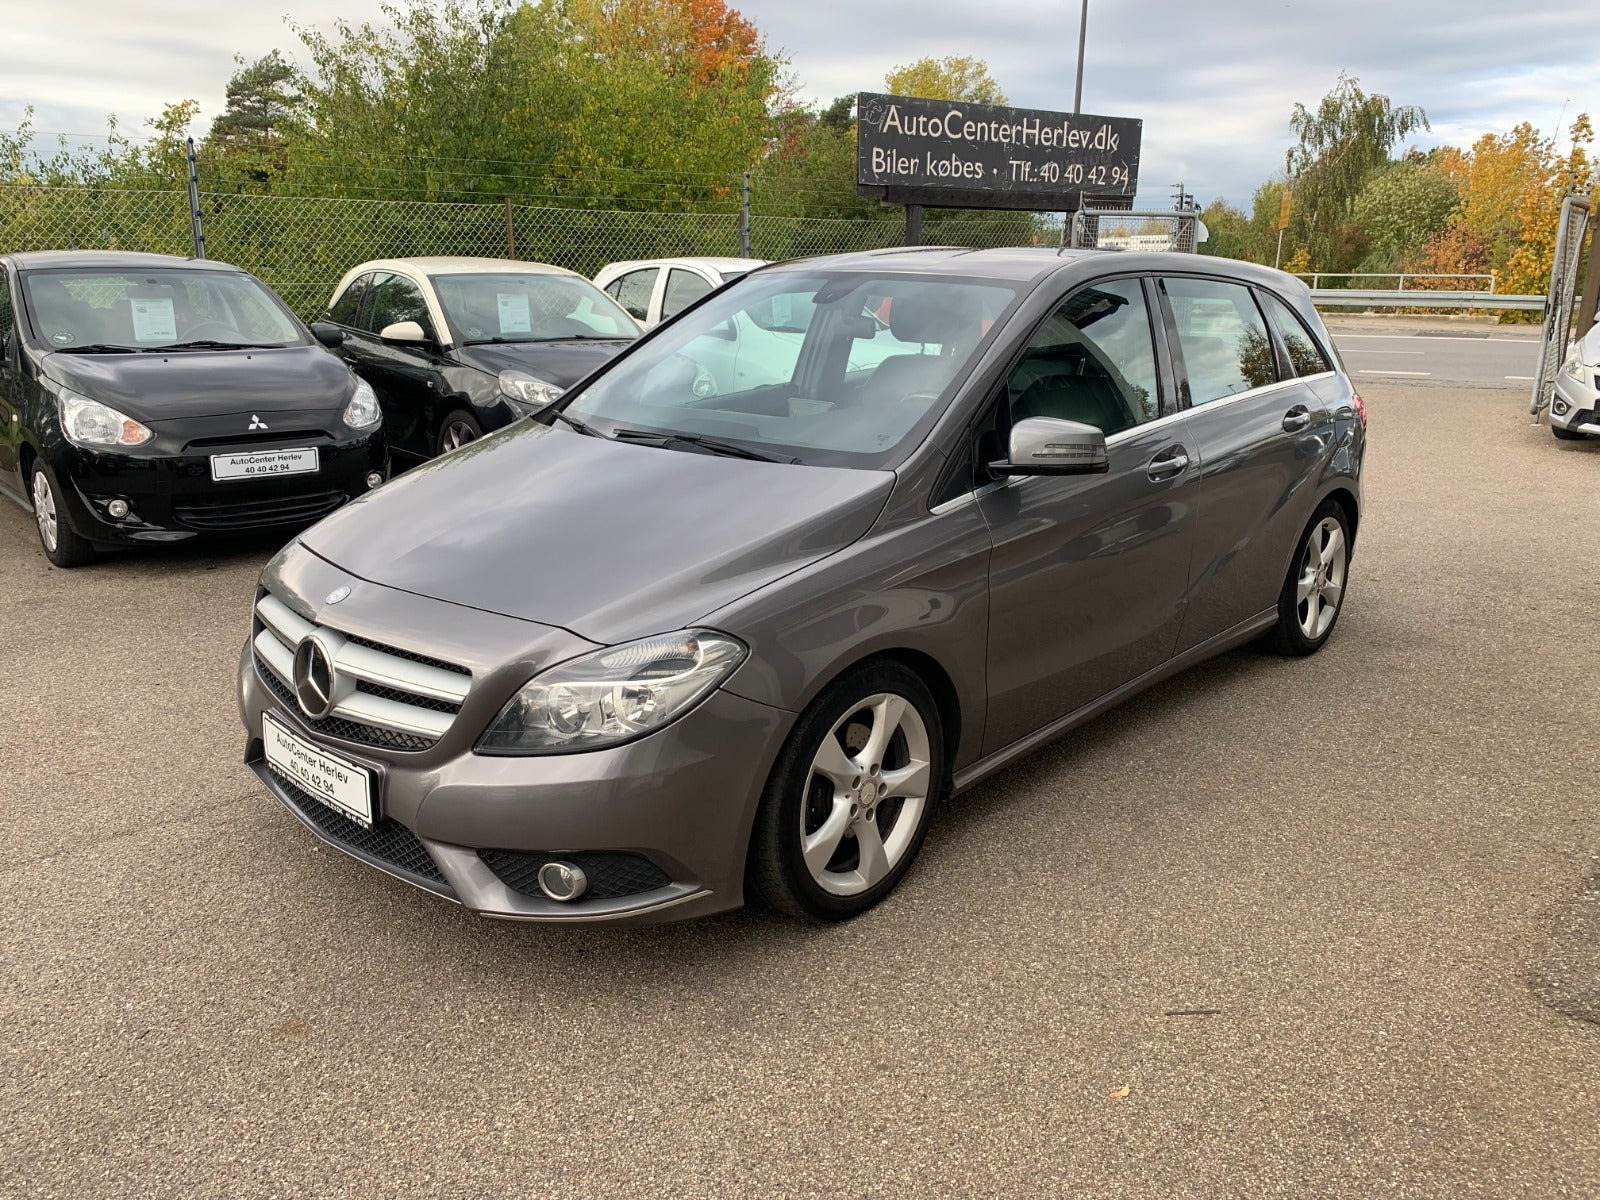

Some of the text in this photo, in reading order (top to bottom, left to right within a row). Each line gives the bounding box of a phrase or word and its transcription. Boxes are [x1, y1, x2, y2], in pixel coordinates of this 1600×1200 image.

[882, 104, 1118, 152] AutoCenterHerlev.dk
[872, 147, 919, 175] Biler
[926, 151, 984, 179] købes
[1064, 164, 1083, 184] 40
[1088, 165, 1106, 186] 42
[1111, 166, 1129, 189] 94
[230, 453, 302, 466] AutoCenter Herlev
[245, 463, 290, 474] 40 40 42 94
[276, 732, 317, 768] AutoCenter
[318, 758, 349, 785] Herlev
[290, 759, 299, 774] 40
[300, 766, 310, 781] 40
[311, 773, 322, 789] 42
[323, 780, 335, 795] 94
